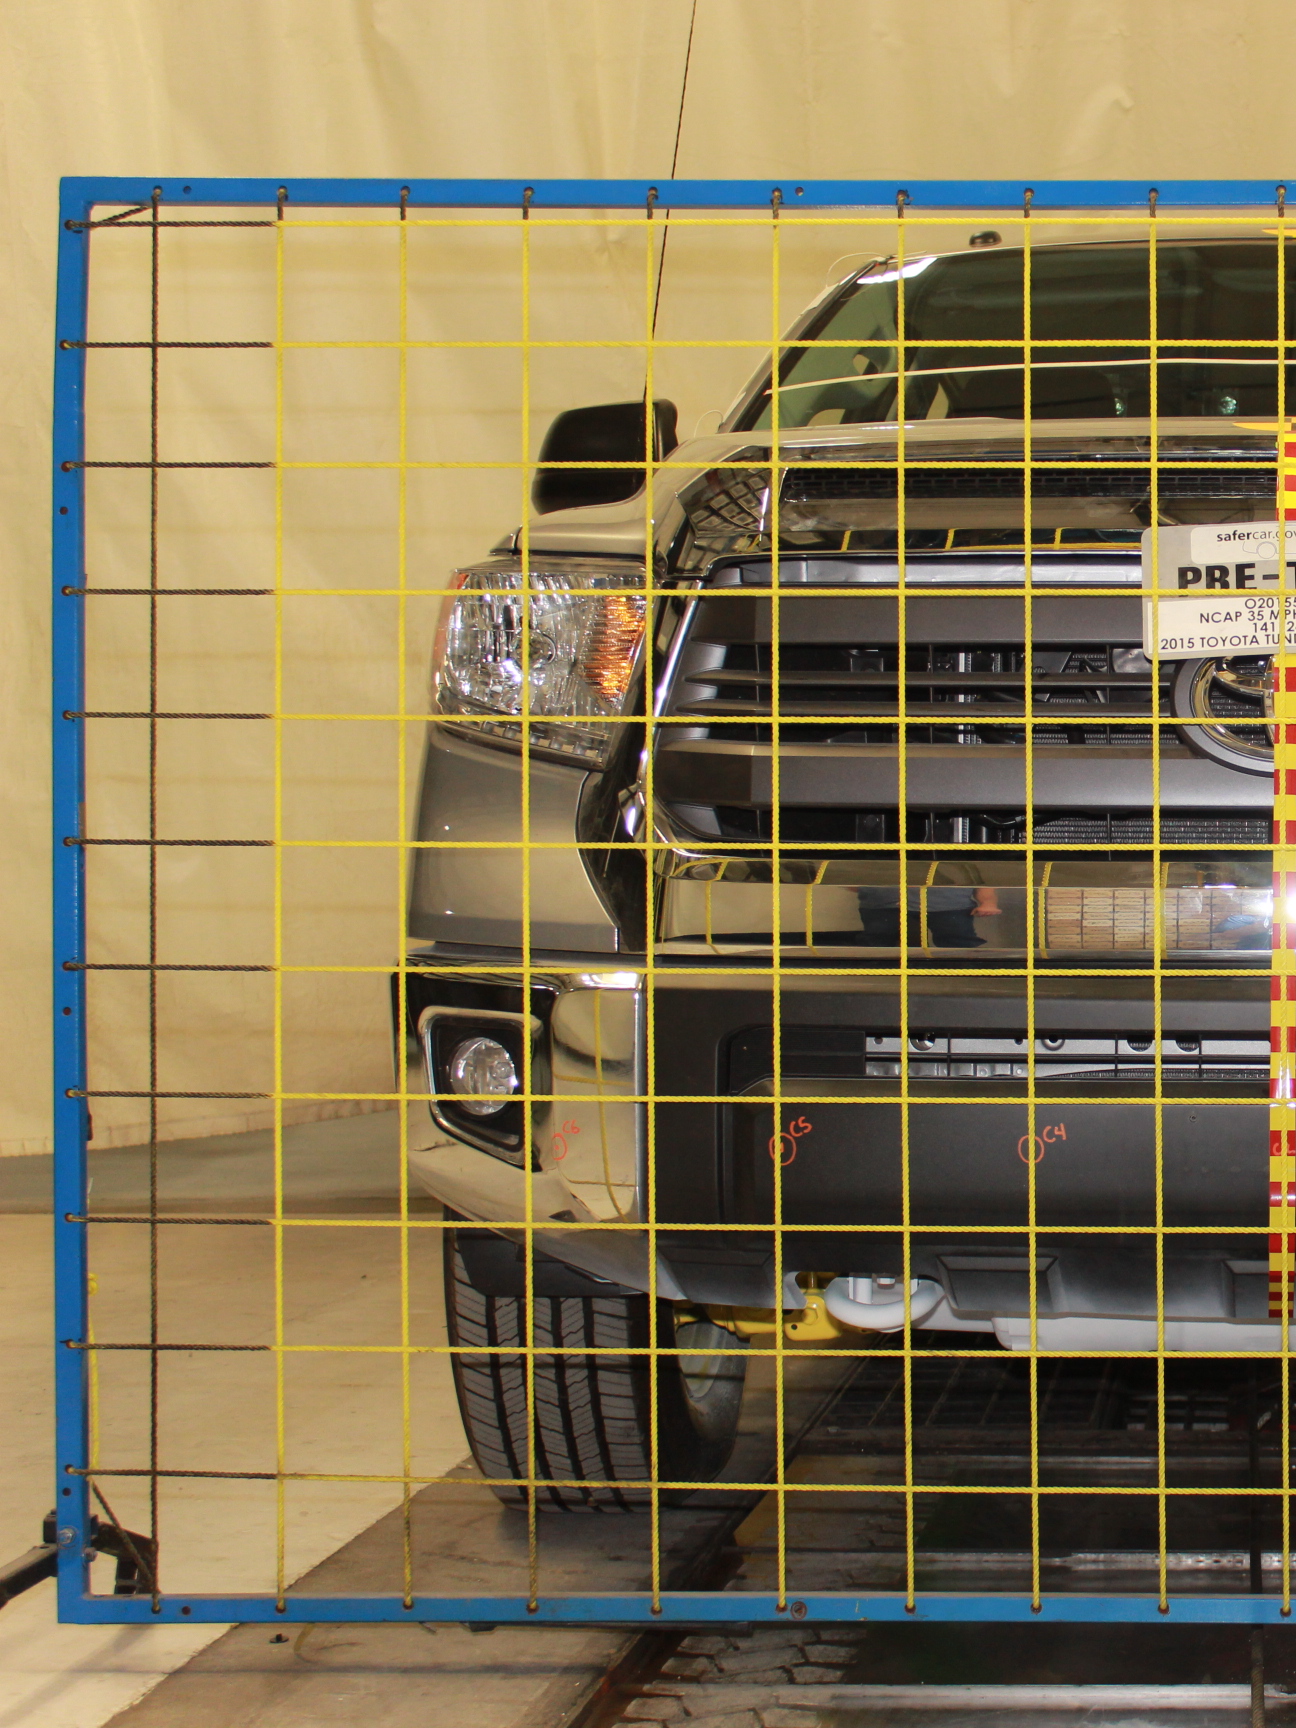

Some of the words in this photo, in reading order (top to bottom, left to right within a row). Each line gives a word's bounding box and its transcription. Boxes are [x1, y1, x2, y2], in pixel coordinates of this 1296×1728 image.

[1199, 611, 1243, 624] NCAP
[1247, 610, 1265, 622] 35
[1160, 637, 1195, 650] 2015
[1199, 635, 1260, 648] TOYOTA
[562, 1118, 581, 1135] C6
[789, 1116, 813, 1138] C5
[1042, 1122, 1067, 1143] C4
